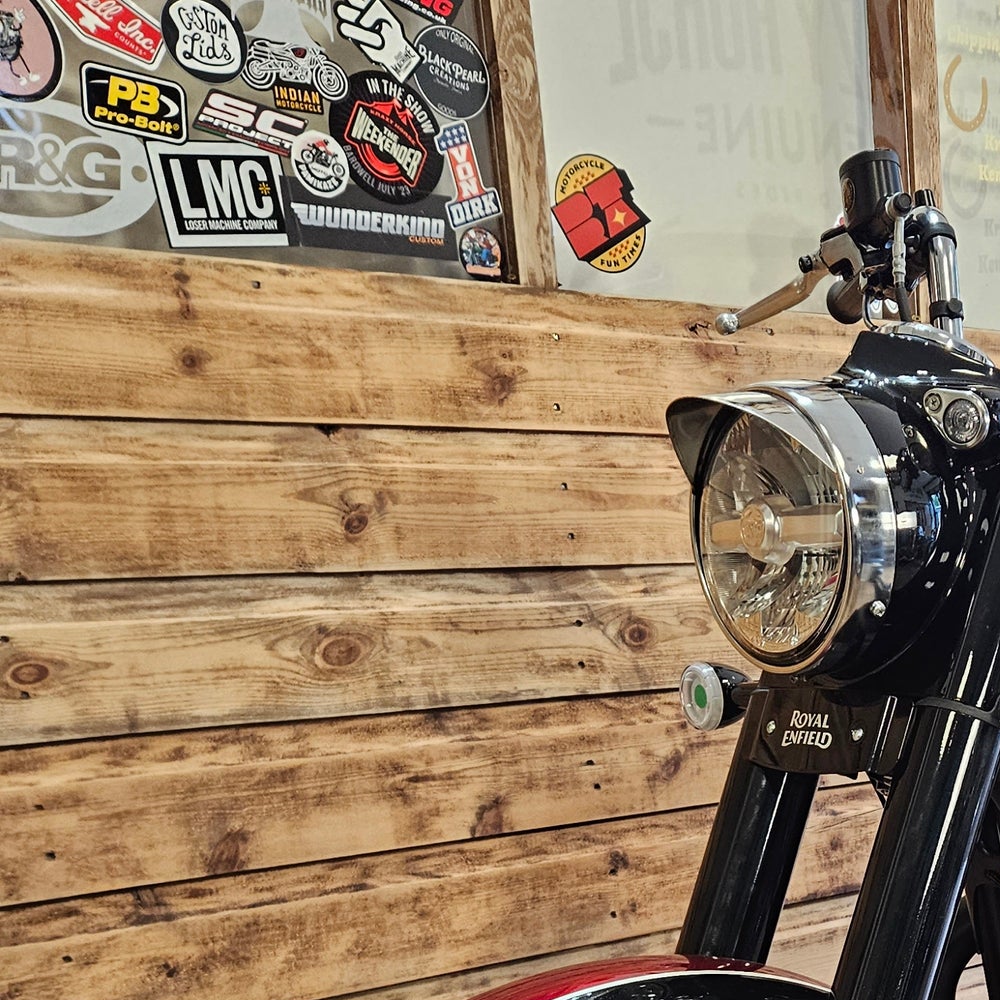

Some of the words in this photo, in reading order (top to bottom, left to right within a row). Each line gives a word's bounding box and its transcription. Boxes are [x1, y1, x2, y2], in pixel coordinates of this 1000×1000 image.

[183, 33, 235, 66] Lids
[419, 44, 453, 73] BLACK
[452, 62, 486, 84] PEARL
[107, 75, 160, 115] PB
[274, 85, 320, 105] INDIAN
[429, 66, 470, 92] CREATIONS
[276, 99, 322, 113] MOTORCYCLE
[366, 78, 380, 94] IN
[381, 79, 406, 103] THE
[404, 94, 435, 134] SHOW
[198, 113, 292, 149] PROJECT
[350, 106, 423, 182] WEEKENDER
[383, 126, 400, 140] THE
[448, 143, 479, 199] VON
[560, 160, 605, 194] MOTORCYCLE
[169, 158, 274, 219] LMC
[378, 181, 396, 196] JULY
[184, 219, 209, 231] LOSER
[209, 219, 243, 231] MACHINE
[243, 219, 278, 231] COMPANY
[450, 192, 498, 226] DIRK
[408, 235, 445, 247] CUSTOM
[600, 258, 620, 268] FUN
[622, 234, 641, 263] TIMES
[789, 709, 830, 729] ROYAL
[781, 729, 833, 750] ENFIELD
